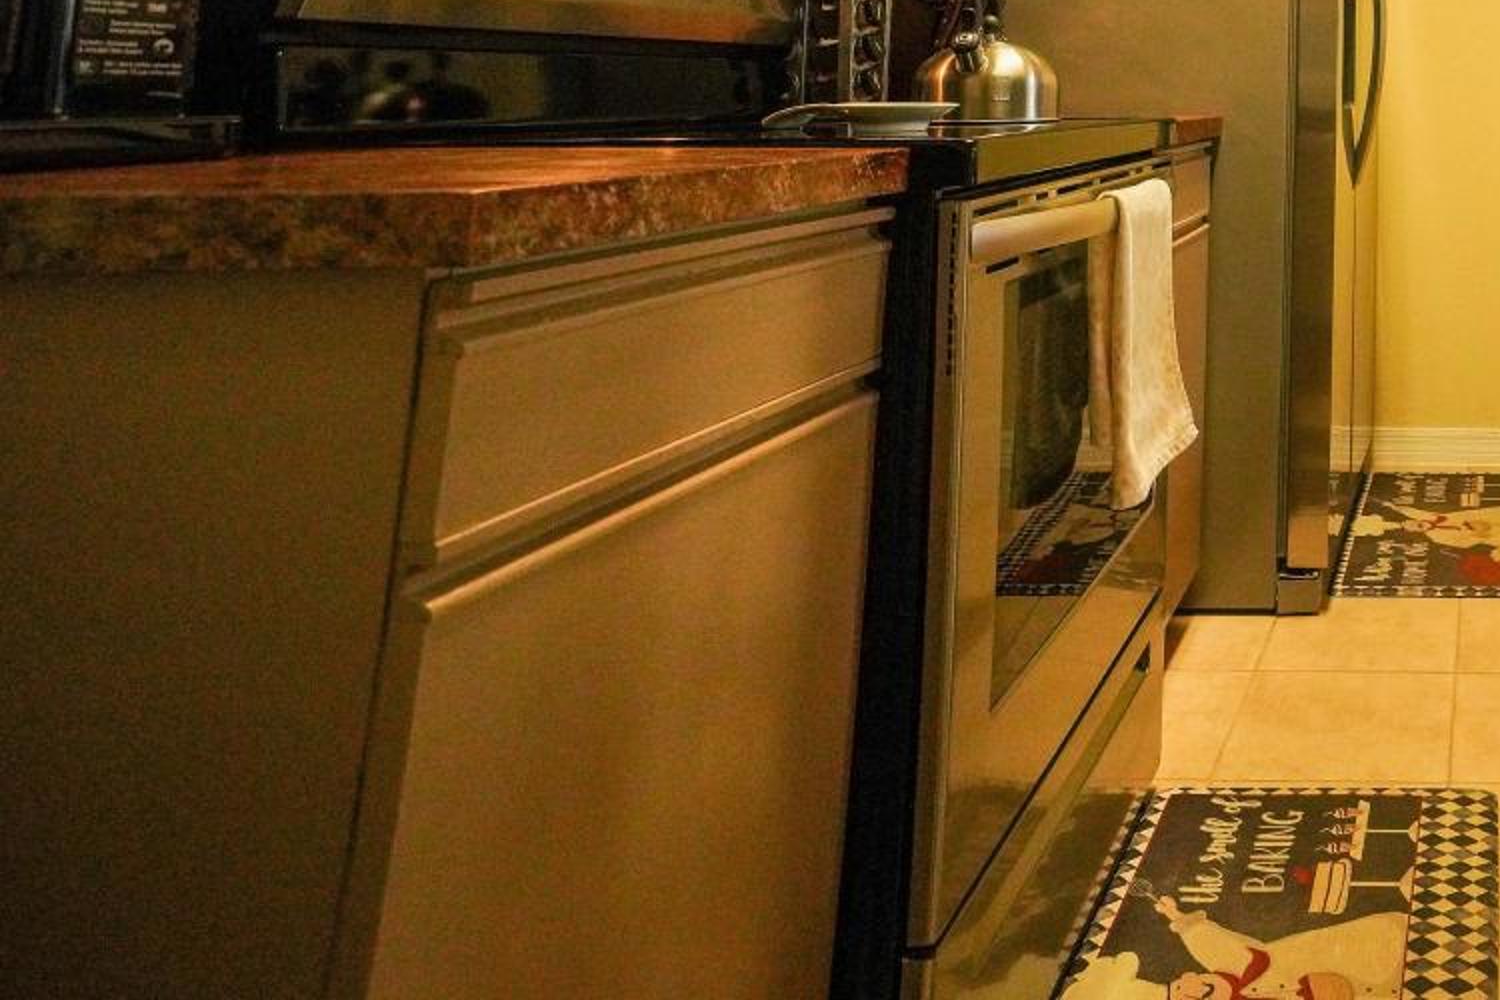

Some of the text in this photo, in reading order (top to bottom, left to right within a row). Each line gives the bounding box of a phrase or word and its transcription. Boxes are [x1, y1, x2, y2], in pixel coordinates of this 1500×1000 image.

[1178, 796, 1263, 903] the smell of
[1241, 809, 1305, 893] BAKING
